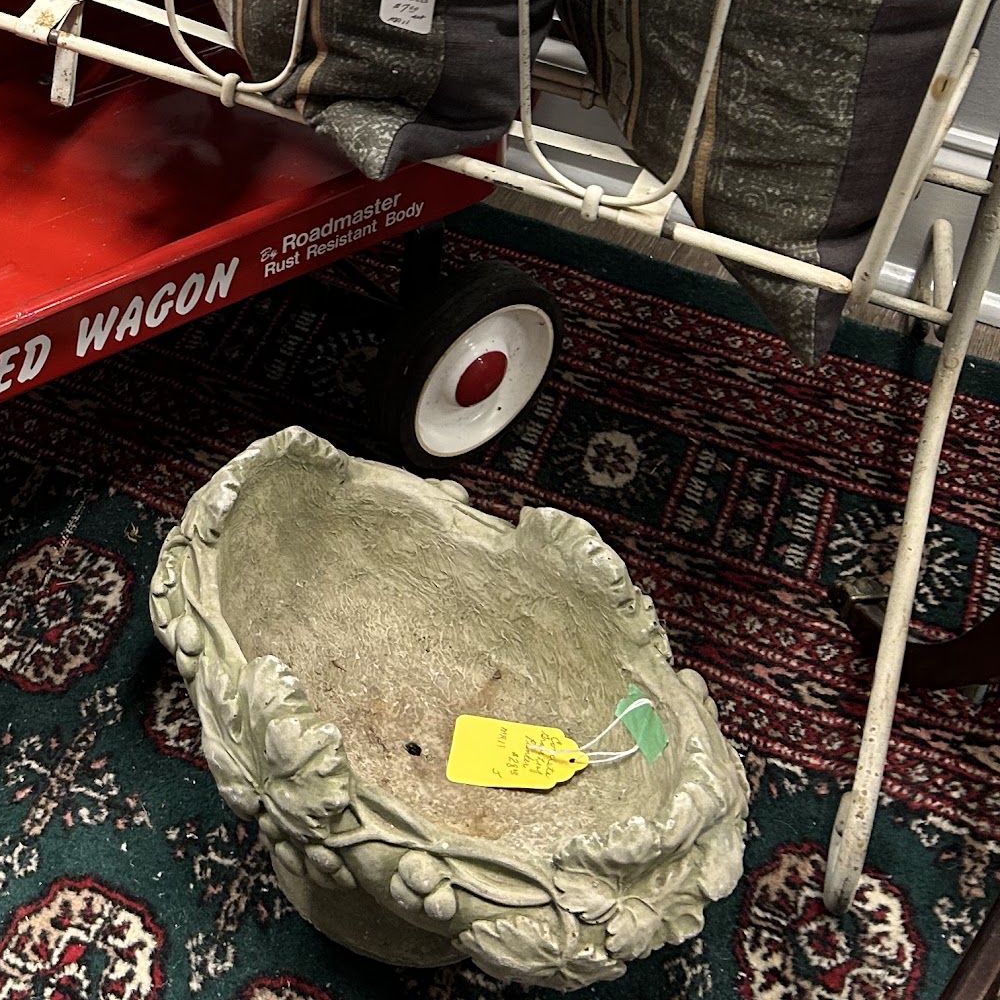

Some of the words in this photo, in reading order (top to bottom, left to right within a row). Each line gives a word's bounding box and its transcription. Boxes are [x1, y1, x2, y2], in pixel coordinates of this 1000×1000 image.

[260, 247, 278, 263] By
[282, 193, 402, 254] Roadmaster
[264, 250, 300, 278] Rust
[306, 219, 378, 261] Resistant
[385, 202, 424, 228] Body
[76, 257, 240, 358] WAGON
